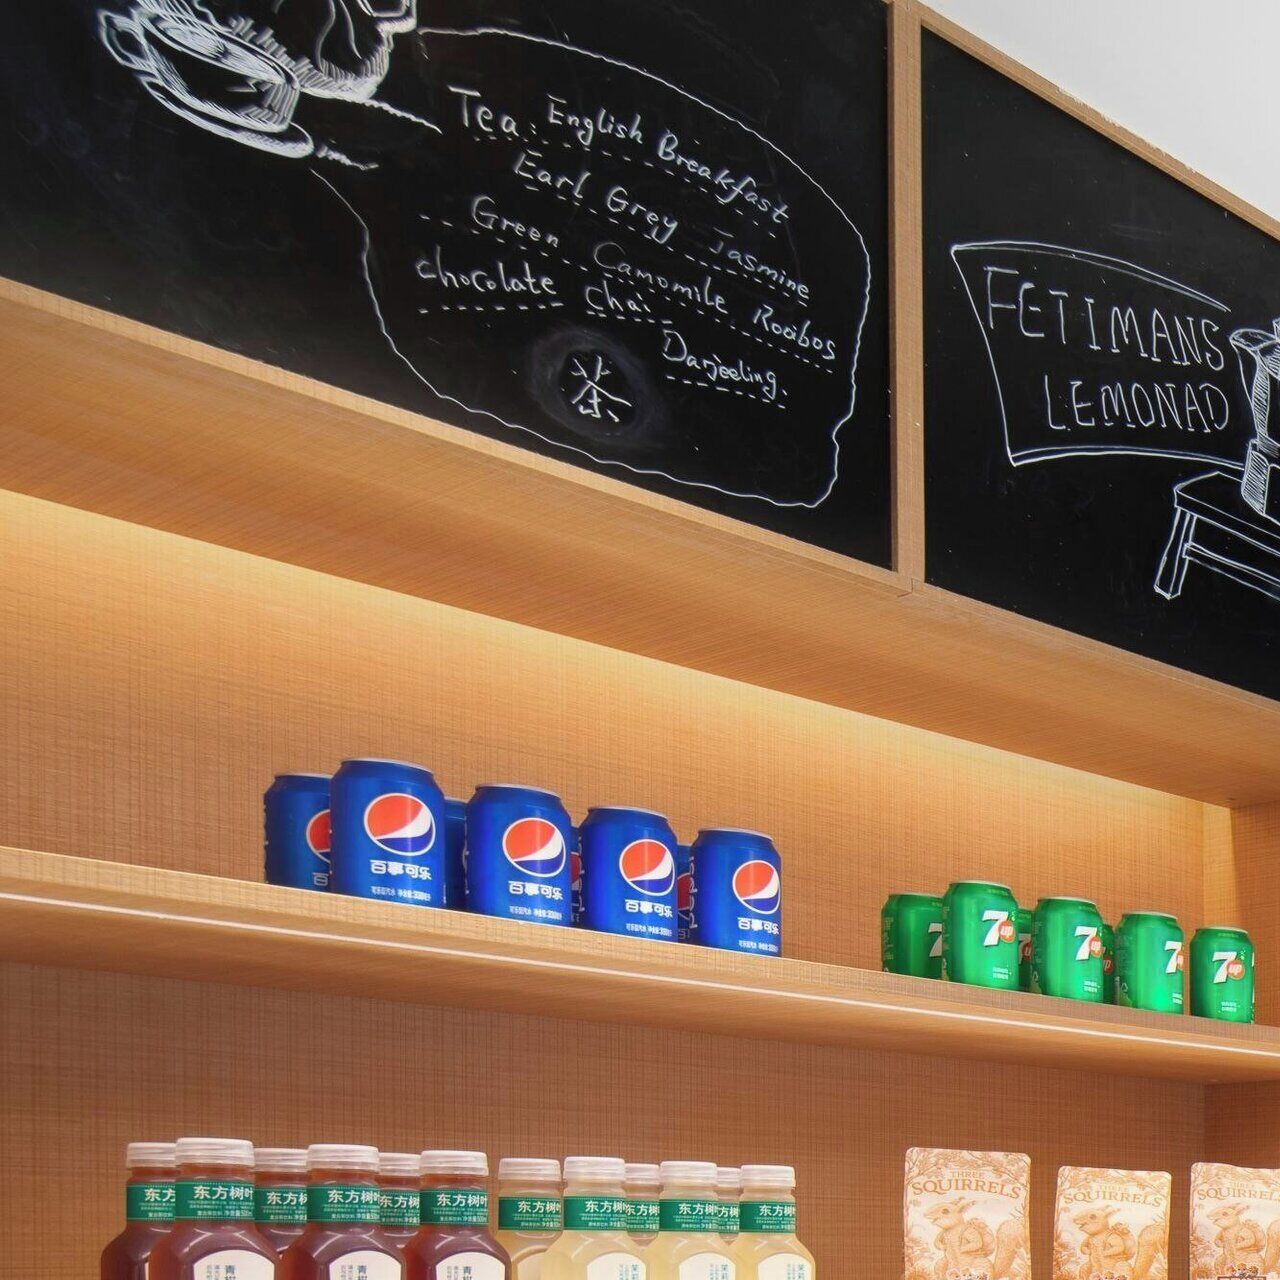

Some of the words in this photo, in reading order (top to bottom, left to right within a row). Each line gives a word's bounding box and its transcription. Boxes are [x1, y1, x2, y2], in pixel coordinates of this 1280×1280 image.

[546, 93, 644, 145] English
[657, 129, 789, 224] Breakfast
[513, 149, 591, 200] Earl
[606, 186, 678, 243] Grey
[709, 227, 810, 299] Jasmine
[472, 196, 559, 248] Green
[593, 241, 729, 313] Camomile
[983, 265, 1224, 371] FETIMANS
[1045, 375, 1229, 433] LEMONAD
[370, 859, 432, 880] 百事可乐
[508, 880, 563, 900] 百事可乐
[624, 899, 673, 918] 百事可乐
[737, 917, 780, 935] 百事可乐
[193, 1185, 253, 1200] 东方树叶
[911, 1178, 1023, 1199] SQUIRRELS
[380, 1195, 420, 1208] 东方树
[1064, 1191, 1162, 1207] SQUIRRELS
[627, 1205, 660, 1217] 东方树
